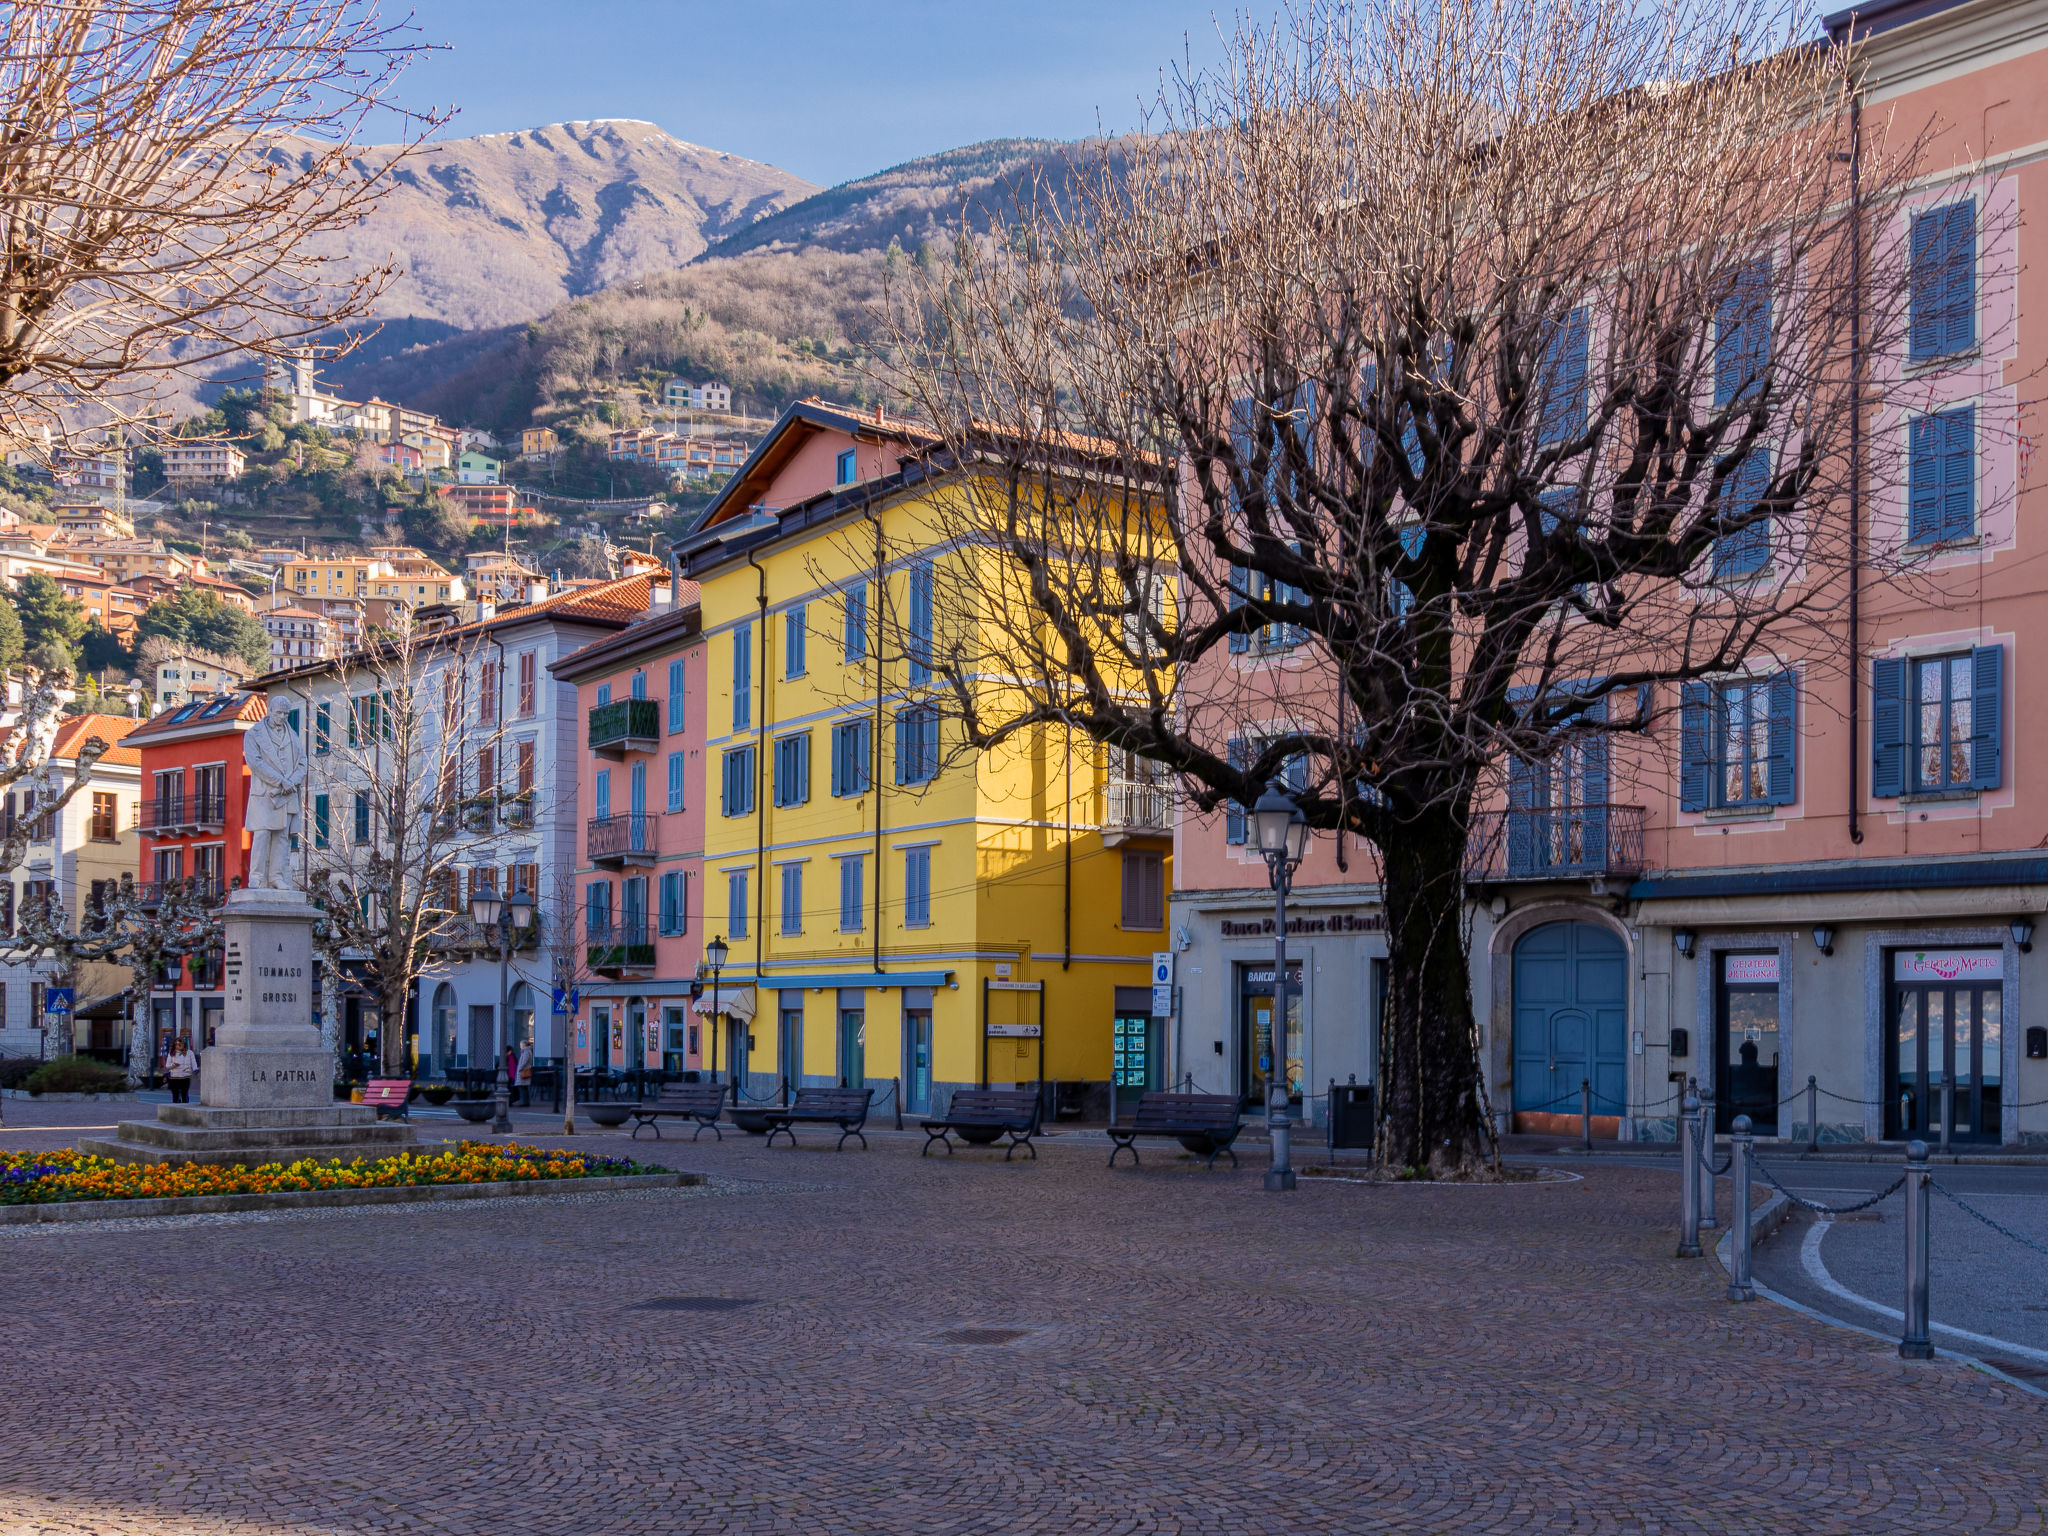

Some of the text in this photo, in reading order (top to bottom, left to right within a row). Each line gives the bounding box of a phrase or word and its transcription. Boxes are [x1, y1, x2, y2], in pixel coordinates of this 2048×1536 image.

[1221, 920, 1261, 935] Banca
[1262, 917, 1325, 933] Poolare
[1327, 914, 1343, 931] di
[277, 943, 283, 952] A
[258, 966, 302, 977] TOMMASO
[1247, 971, 1290, 982] BANCOT
[262, 992, 297, 1003] GROSSI
[252, 1070, 317, 1082] LA PATRIA
